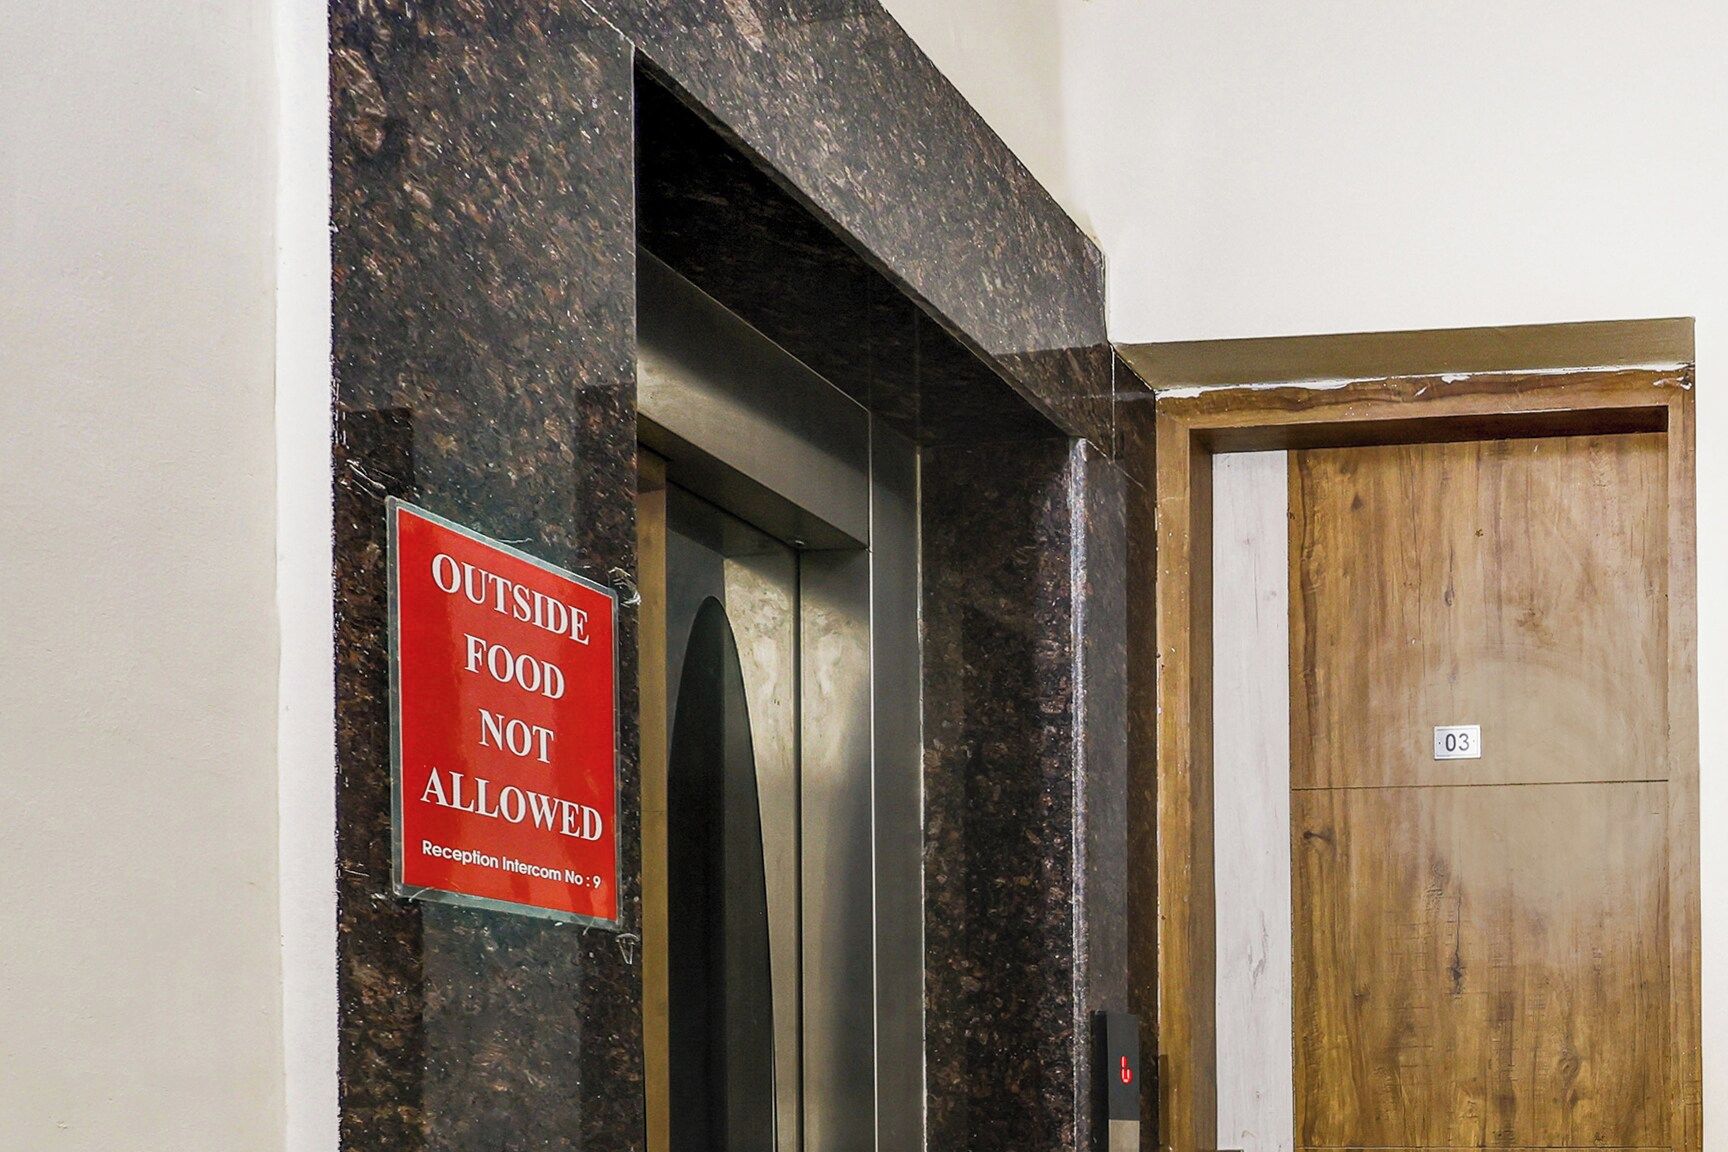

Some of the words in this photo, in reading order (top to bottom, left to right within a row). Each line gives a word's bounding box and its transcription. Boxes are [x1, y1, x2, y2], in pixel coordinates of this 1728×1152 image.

[431, 553, 590, 646] OUTSIDE
[463, 632, 566, 700] FOOD
[478, 708, 555, 764] NOT
[1445, 733, 1470, 752] 03
[420, 767, 603, 842] ALLOWED
[422, 839, 499, 869] Reception
[502, 856, 562, 882] Intercom
[564, 869, 584, 886] No
[592, 875, 602, 889] 9
